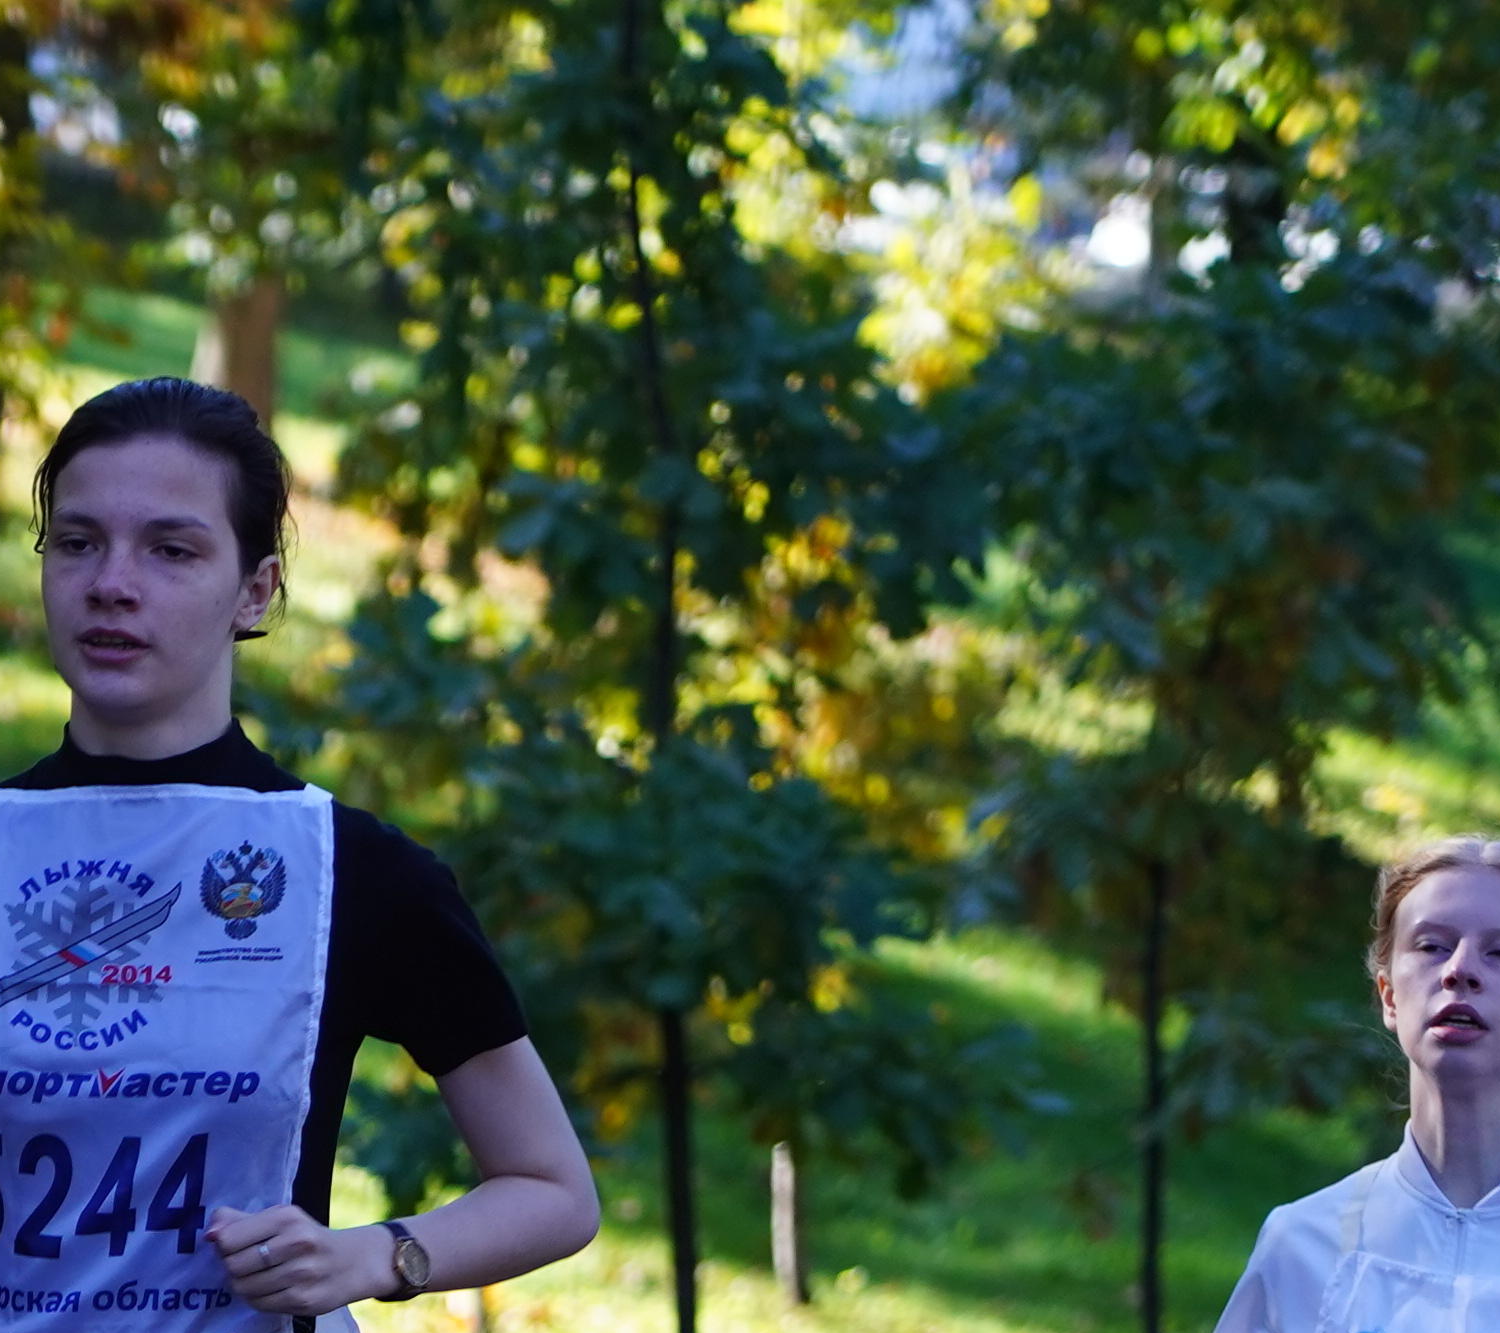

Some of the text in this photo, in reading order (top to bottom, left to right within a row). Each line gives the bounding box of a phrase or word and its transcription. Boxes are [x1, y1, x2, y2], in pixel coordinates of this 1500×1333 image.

[18, 859, 155, 903] ЛЫЖНЯ
[100, 964, 173, 985] 2014
[9, 1008, 149, 1051] РОССИИ
[91, 1278, 234, 1315] область
